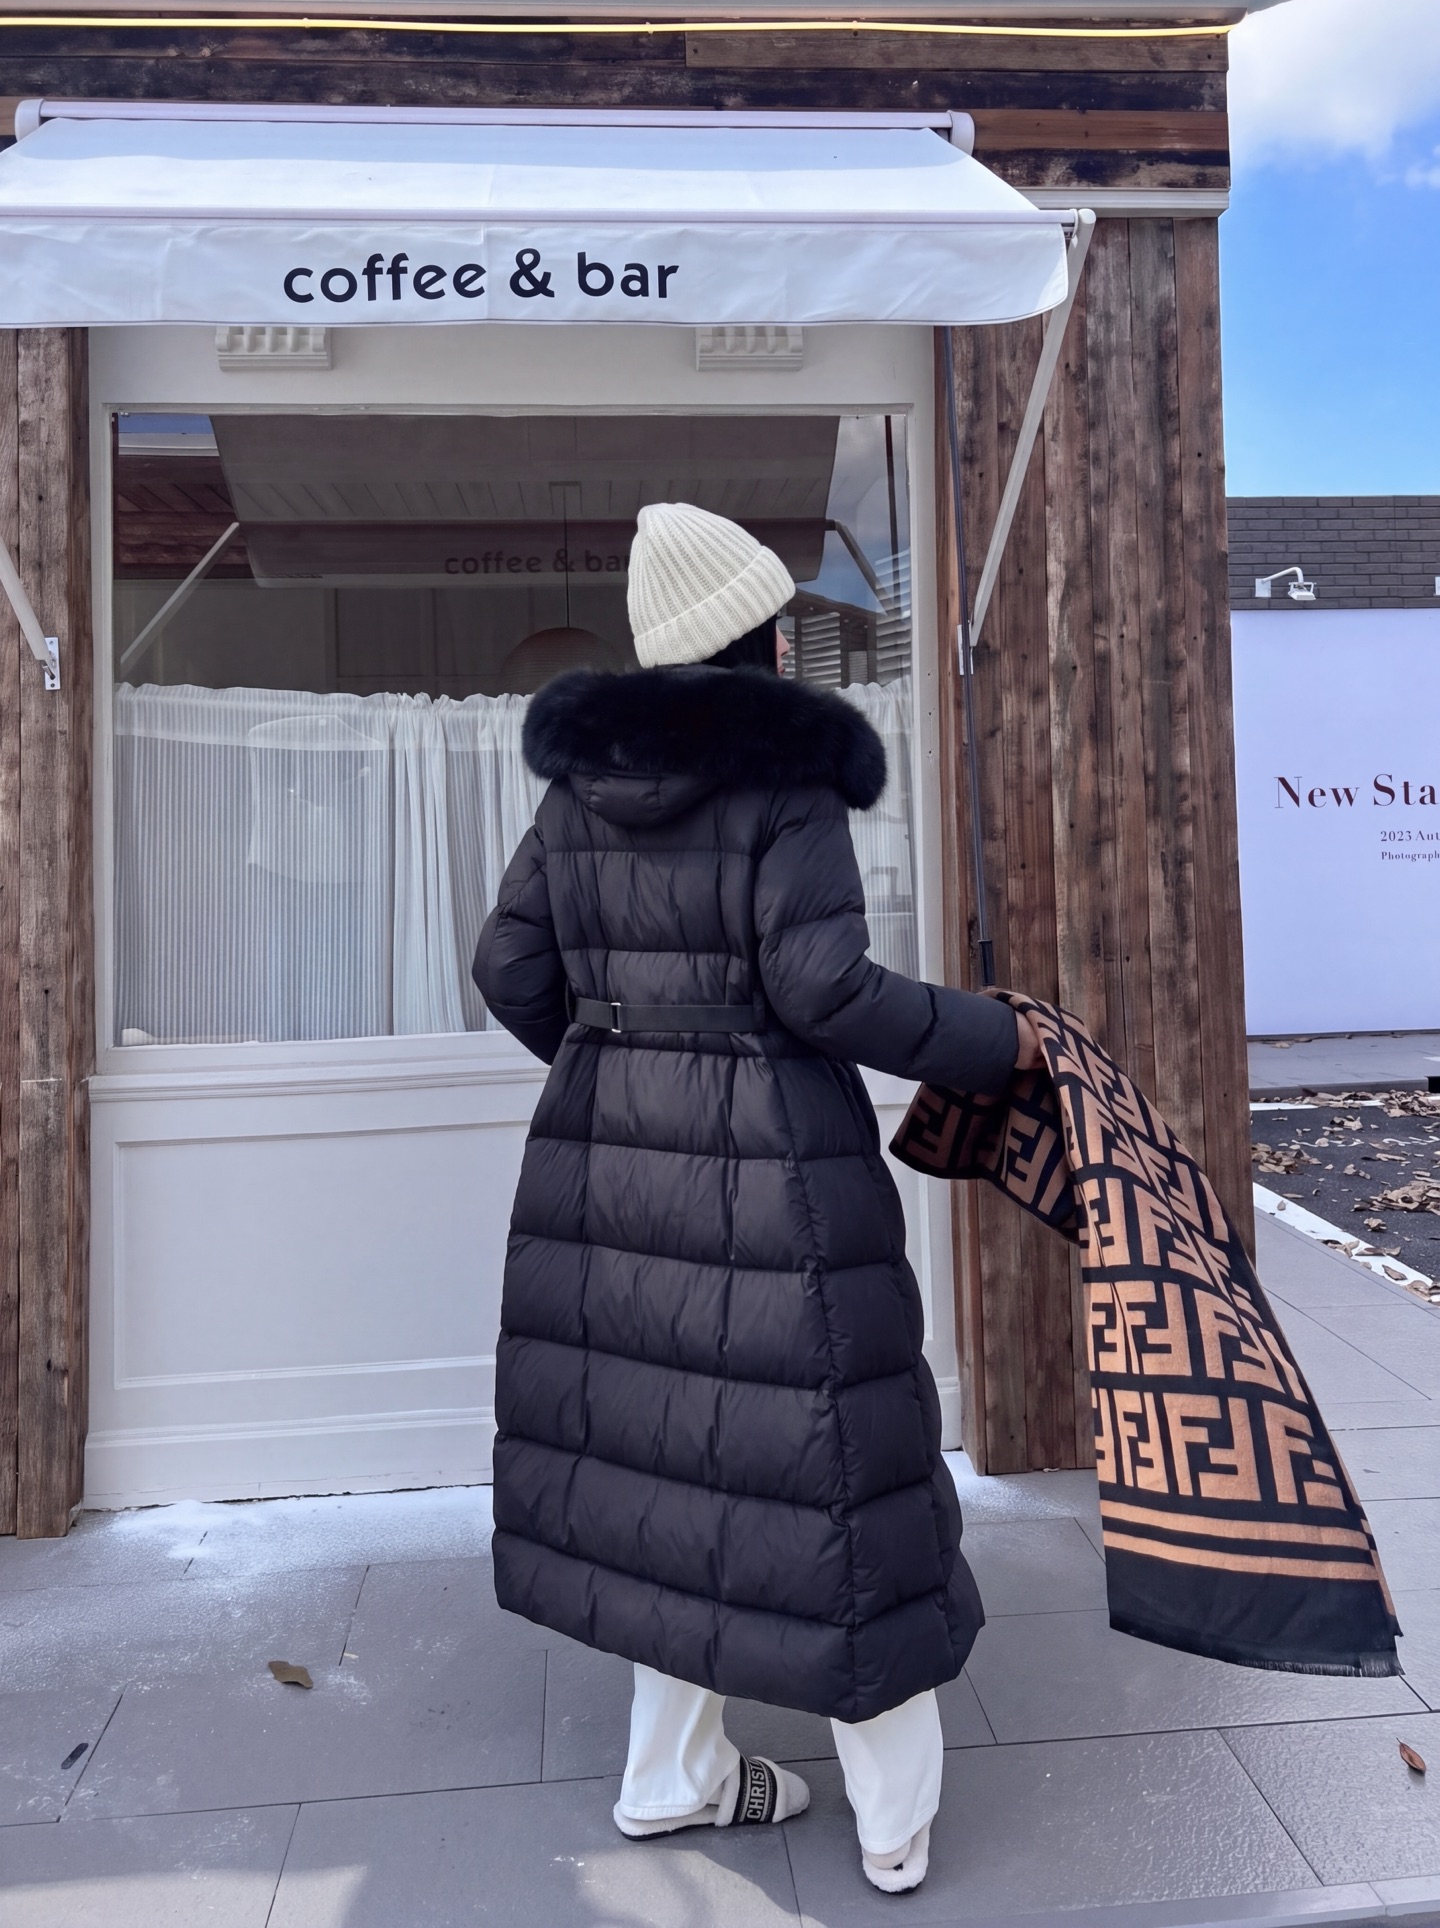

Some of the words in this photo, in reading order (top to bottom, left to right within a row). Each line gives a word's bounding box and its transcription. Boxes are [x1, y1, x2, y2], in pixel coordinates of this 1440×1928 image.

[283, 252, 488, 303] coffee
[509, 248, 555, 298] &
[577, 251, 680, 299] bar
[444, 551, 543, 574] coffee
[552, 548, 576, 573] &
[1273, 776, 1361, 809] New
[1372, 773, 1440, 807] Sta
[1380, 830, 1412, 842] 2023
